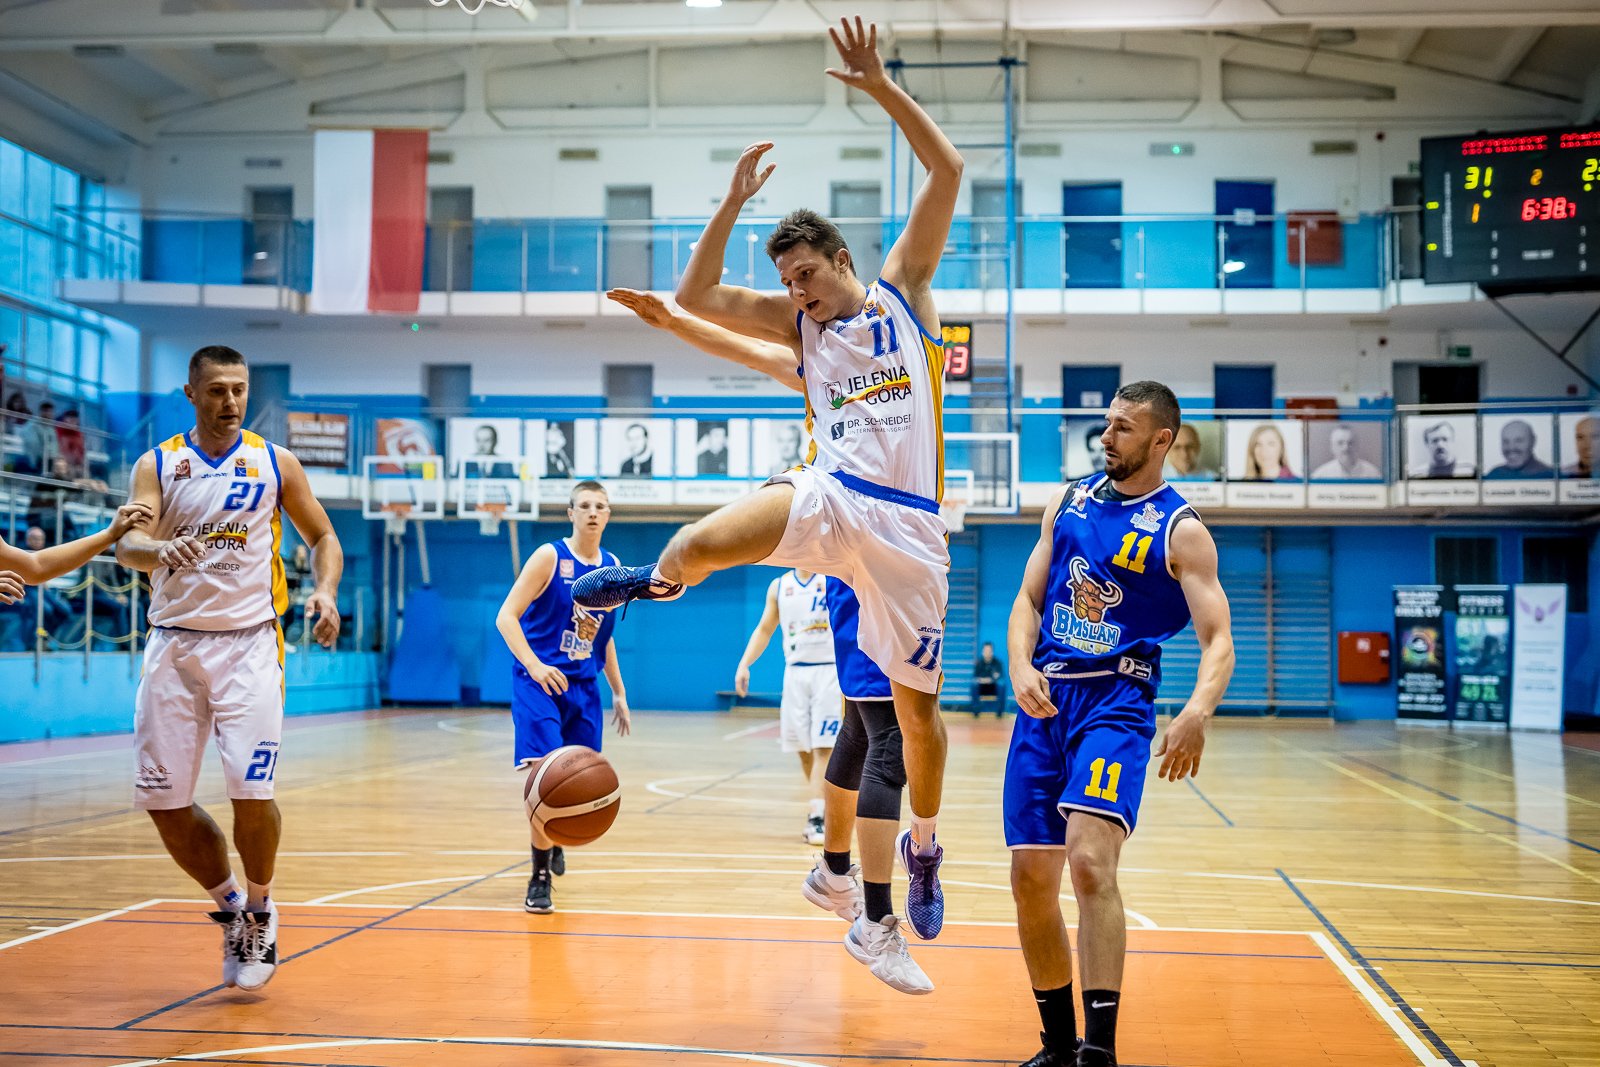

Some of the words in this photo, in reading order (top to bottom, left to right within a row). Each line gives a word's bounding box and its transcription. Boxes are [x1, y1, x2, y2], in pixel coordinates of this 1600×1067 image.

[1464, 166, 1493, 190] 31
[1530, 168, 1543, 186] 2
[1582, 158, 1600, 181] 2
[868, 316, 900, 359] 11
[944, 346, 969, 374] 13
[847, 365, 910, 394] JELENIA
[865, 384, 912, 405] GÓRA
[847, 418, 862, 428] DR.
[222, 481, 266, 512] 21
[194, 522, 248, 537] JELENIA
[204, 534, 245, 551] GÓRA
[1112, 531, 1154, 574] 11
[198, 561, 240, 571] CHNEIDER
[811, 596, 827, 611] 14
[904, 635, 942, 672] 11
[819, 720, 839, 736] 14
[1084, 757, 1122, 803] 11
